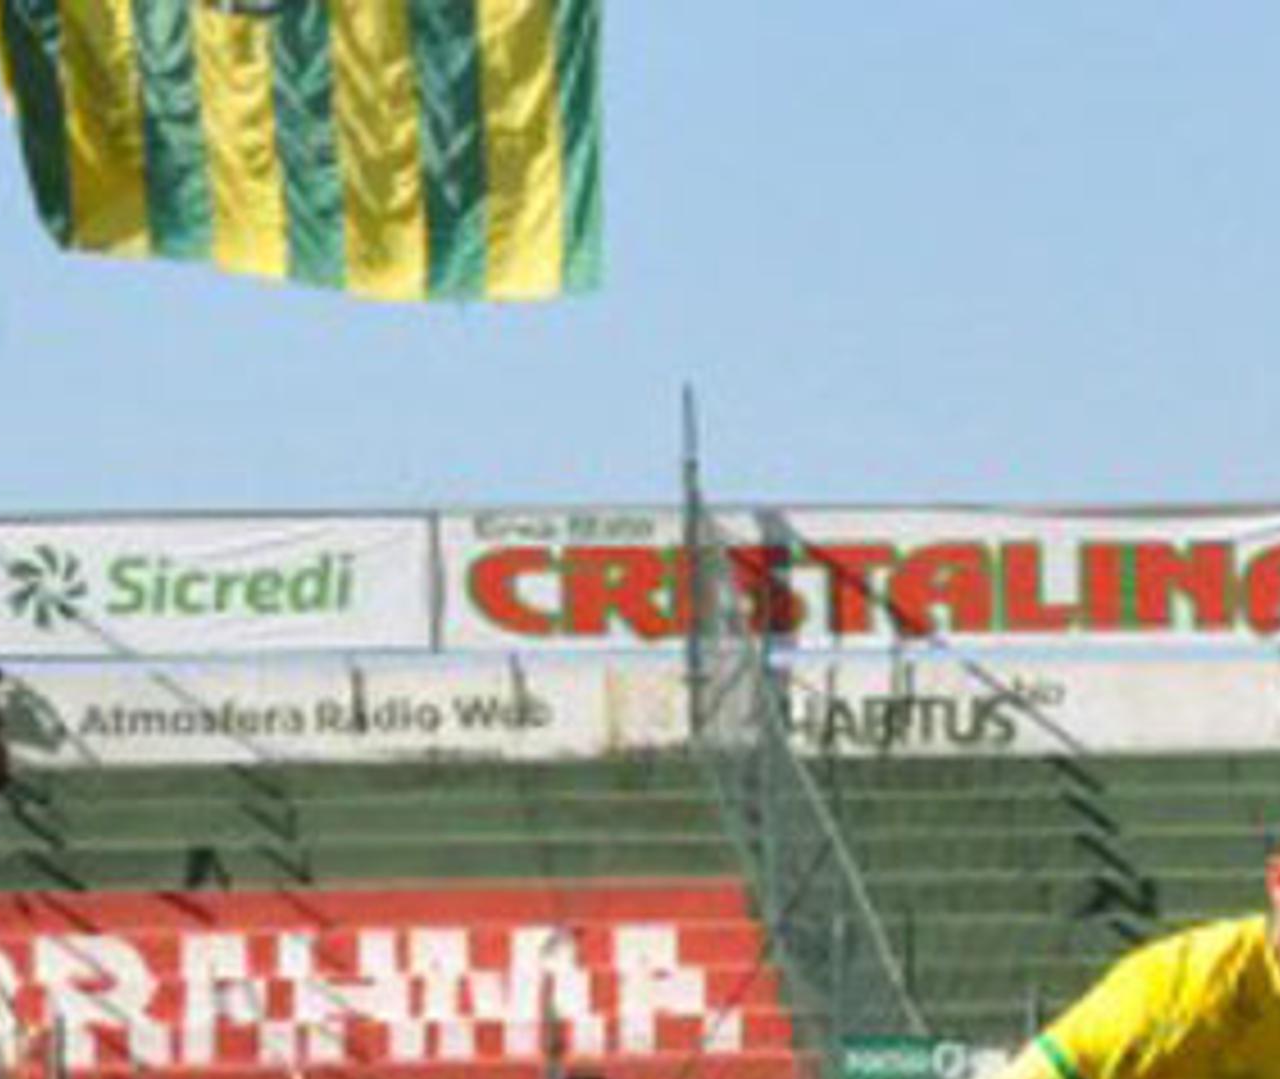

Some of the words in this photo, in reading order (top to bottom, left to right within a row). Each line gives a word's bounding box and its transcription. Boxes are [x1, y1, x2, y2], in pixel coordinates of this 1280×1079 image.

[106, 552, 353, 615] Sicredi
[78, 696, 306, 736] Atmosfera
[453, 691, 554, 731] Web
